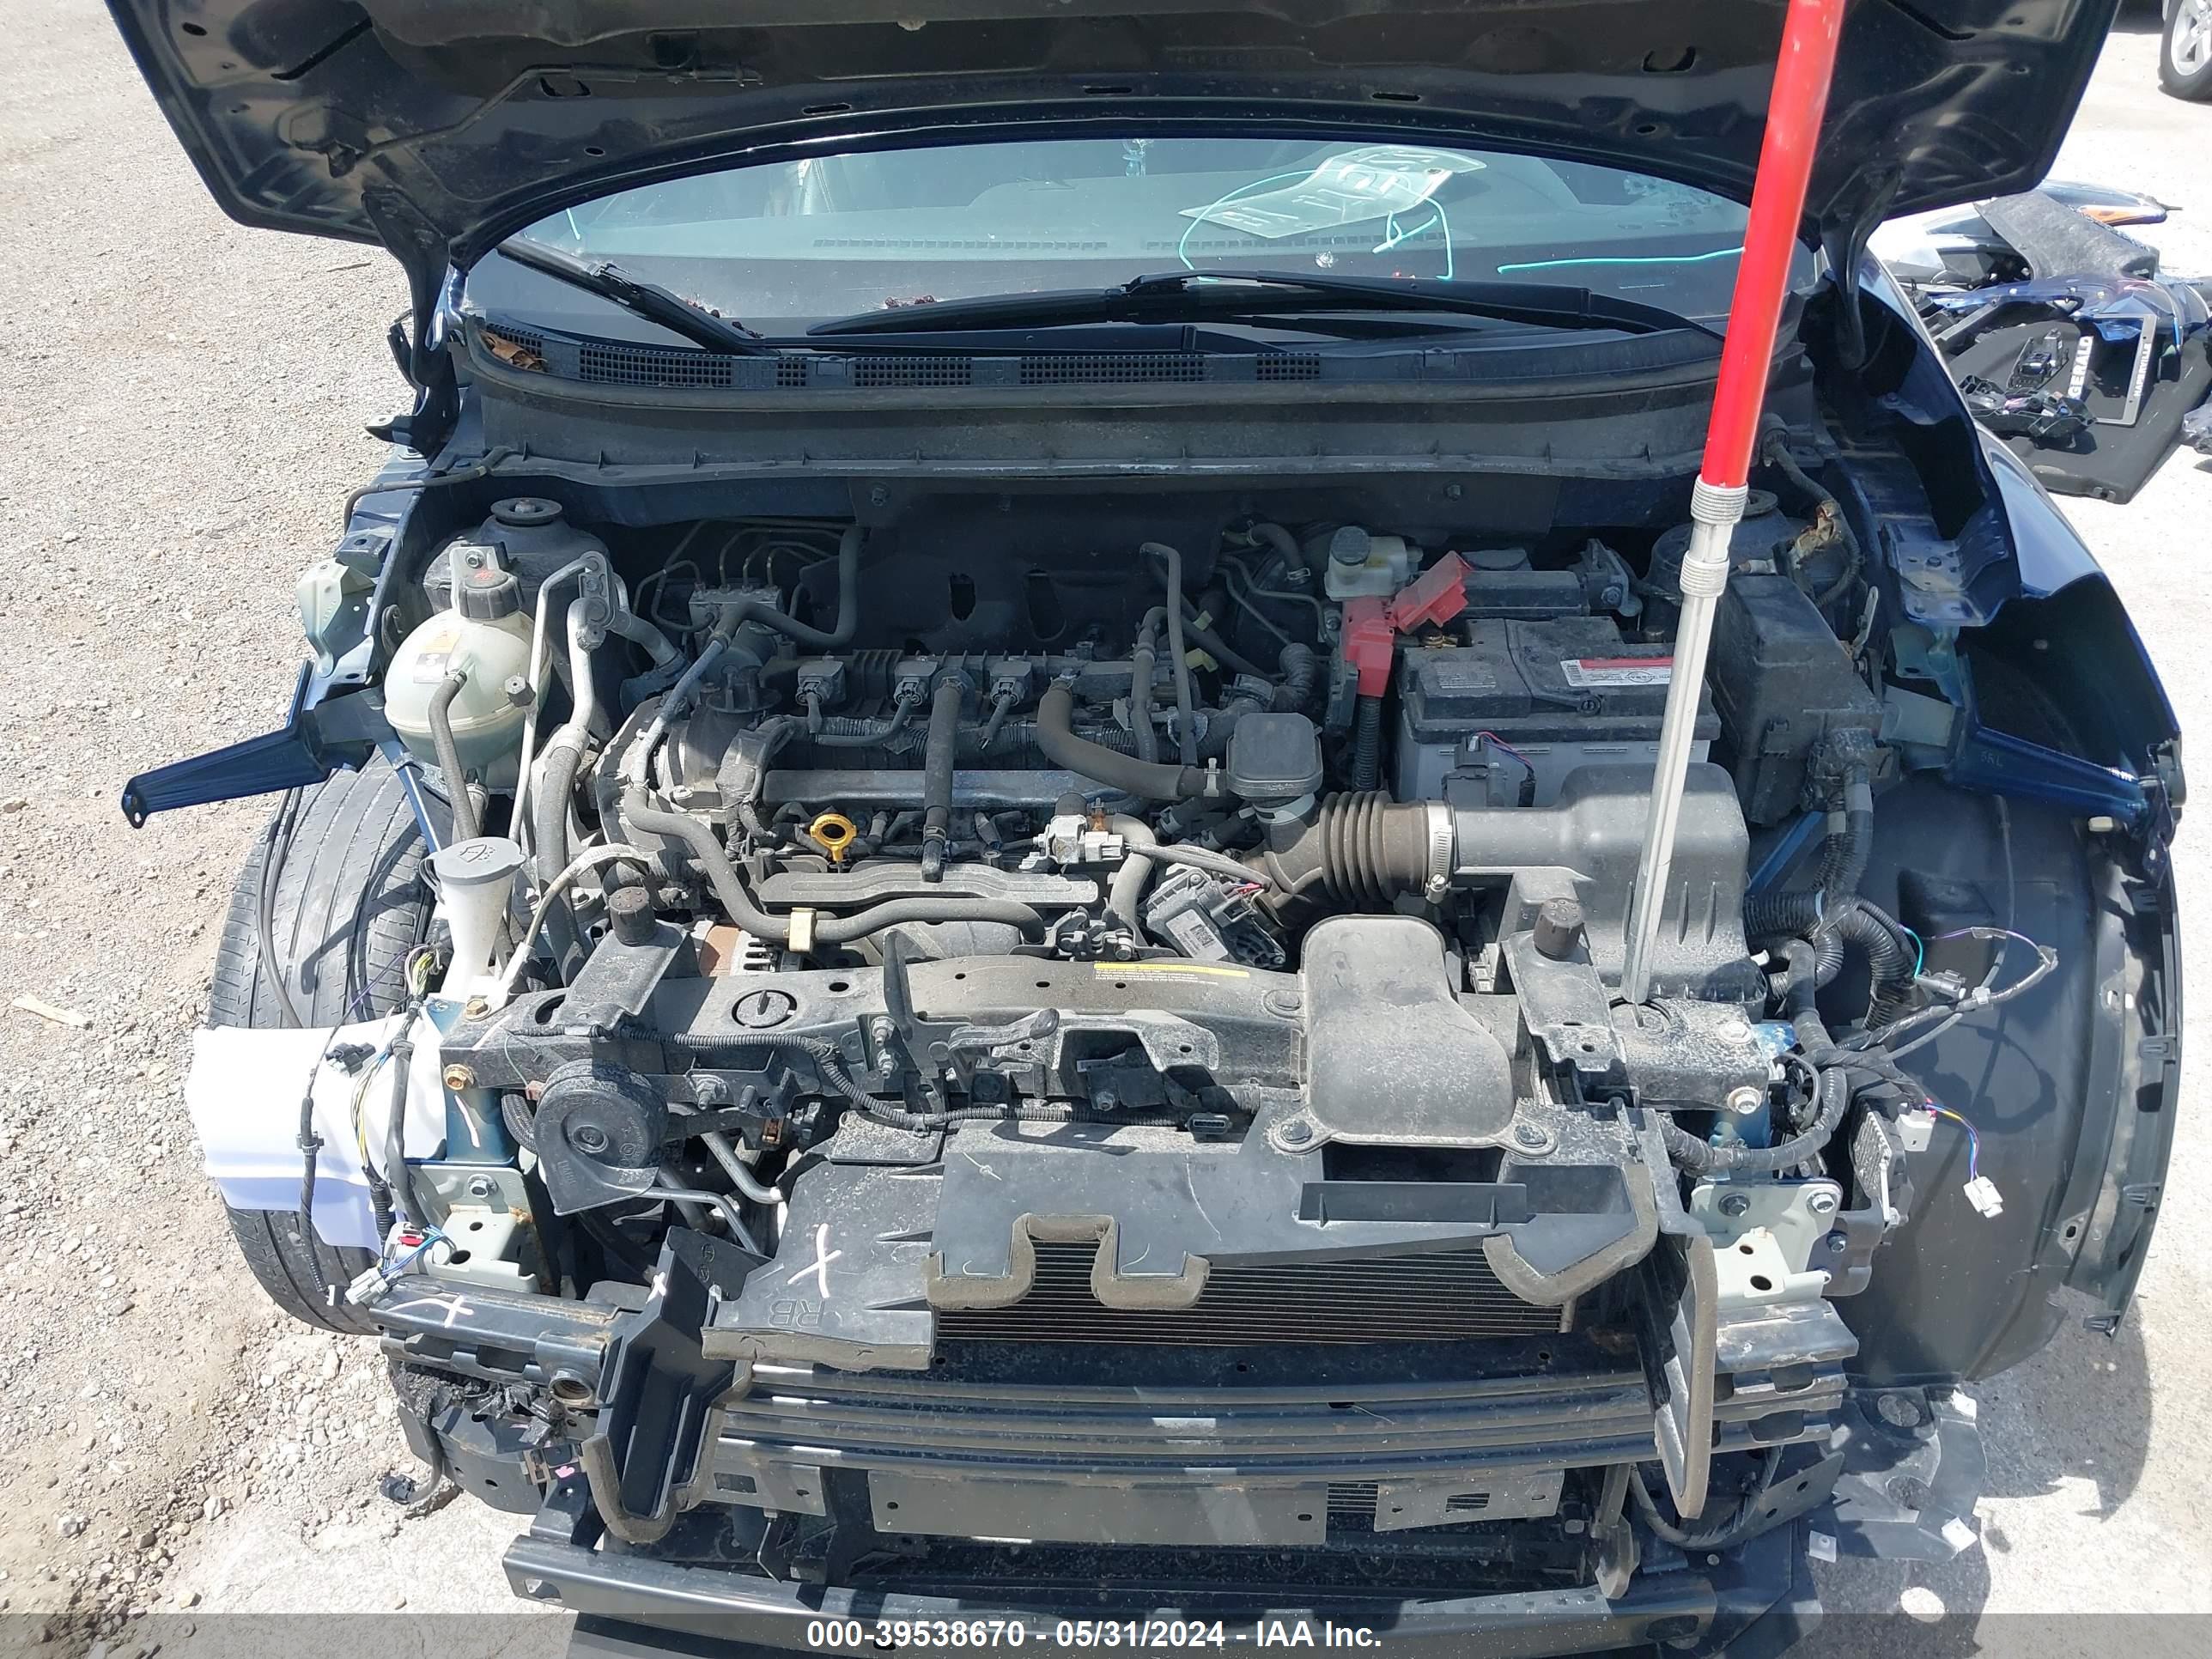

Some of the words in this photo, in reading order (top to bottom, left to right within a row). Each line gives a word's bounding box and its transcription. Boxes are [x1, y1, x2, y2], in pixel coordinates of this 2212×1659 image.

[2068, 336, 2094, 399] GERALD
[2133, 343, 2152, 397] NAPERVILLE
[769, 1299, 826, 1328] RB
